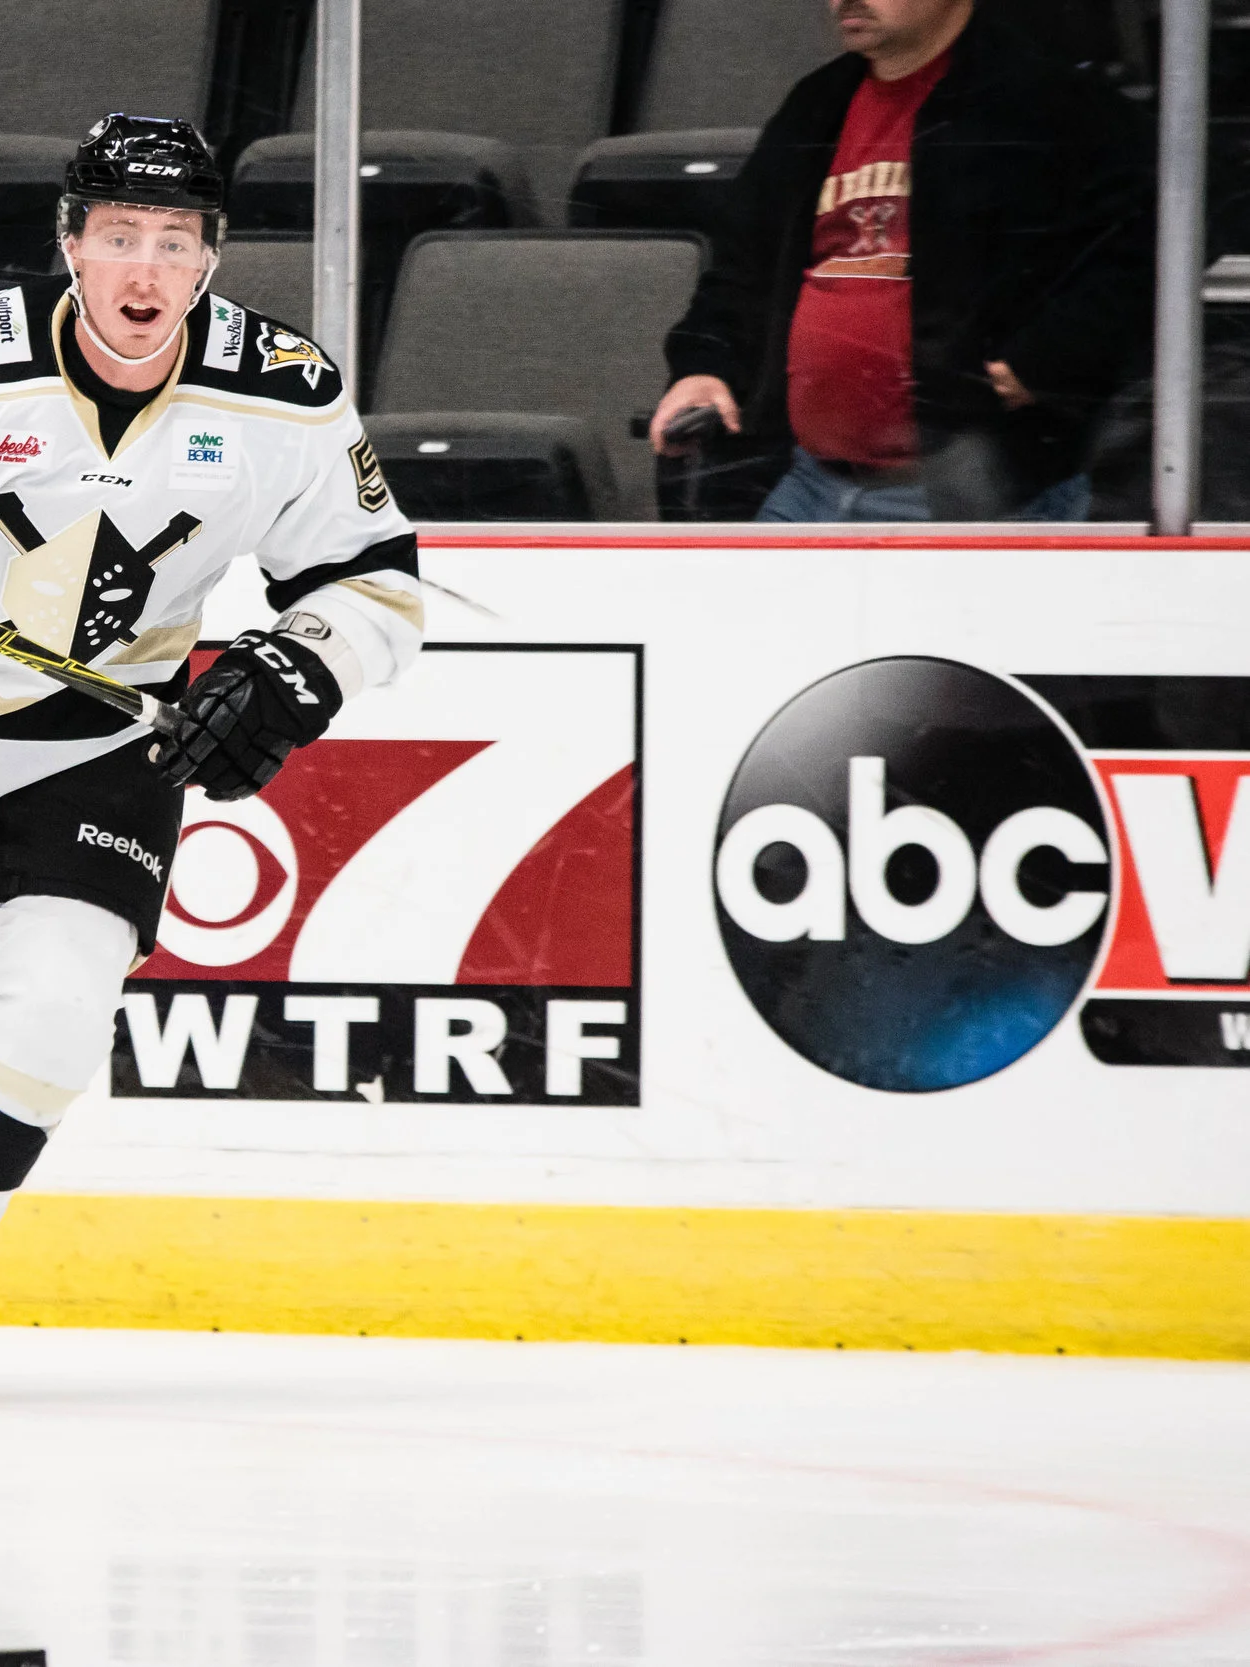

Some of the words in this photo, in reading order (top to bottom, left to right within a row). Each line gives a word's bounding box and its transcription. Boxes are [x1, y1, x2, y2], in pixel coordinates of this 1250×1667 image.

[127, 162, 182, 177] CCM
[80, 474, 133, 488] CCM
[228, 635, 320, 704] CCM
[76, 823, 163, 883] Reebok
[716, 756, 1110, 947] abc
[124, 993, 627, 1097] WTRF
